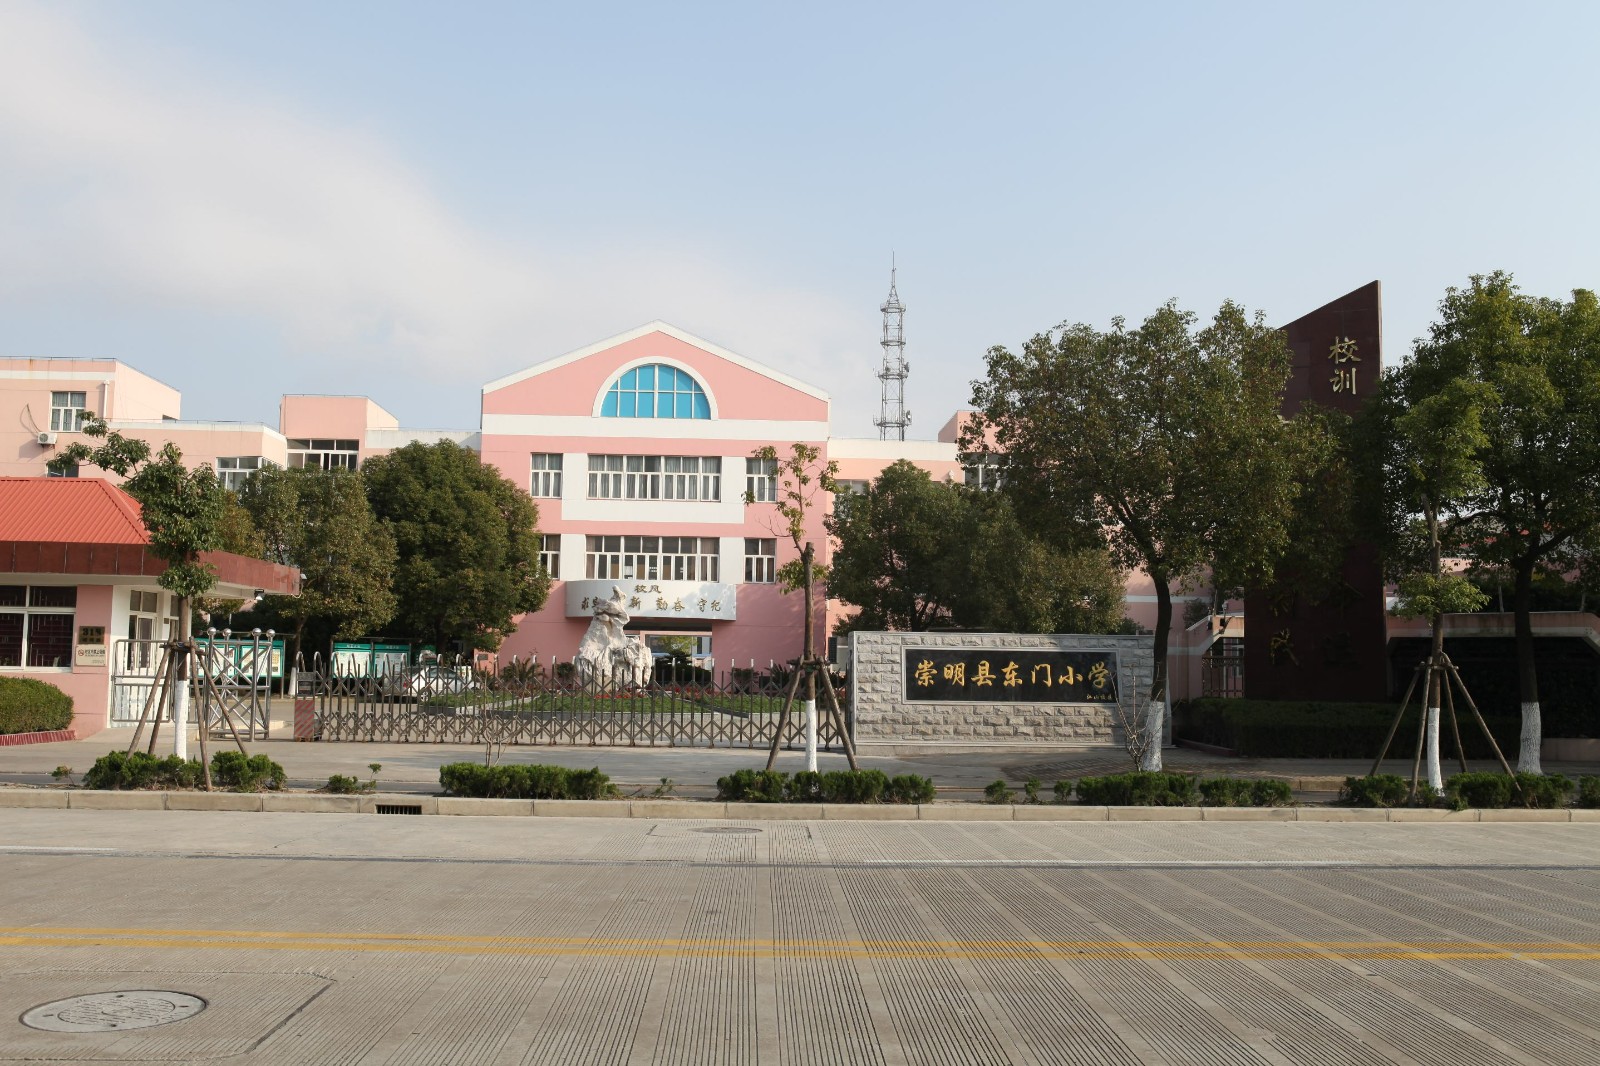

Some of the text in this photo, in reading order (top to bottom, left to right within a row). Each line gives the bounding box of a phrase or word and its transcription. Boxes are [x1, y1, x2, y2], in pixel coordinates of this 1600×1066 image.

[1328, 336, 1361, 395] 校训
[634, 584, 661, 593] 校风
[914, 659, 1110, 688] 崇明县东门小学
